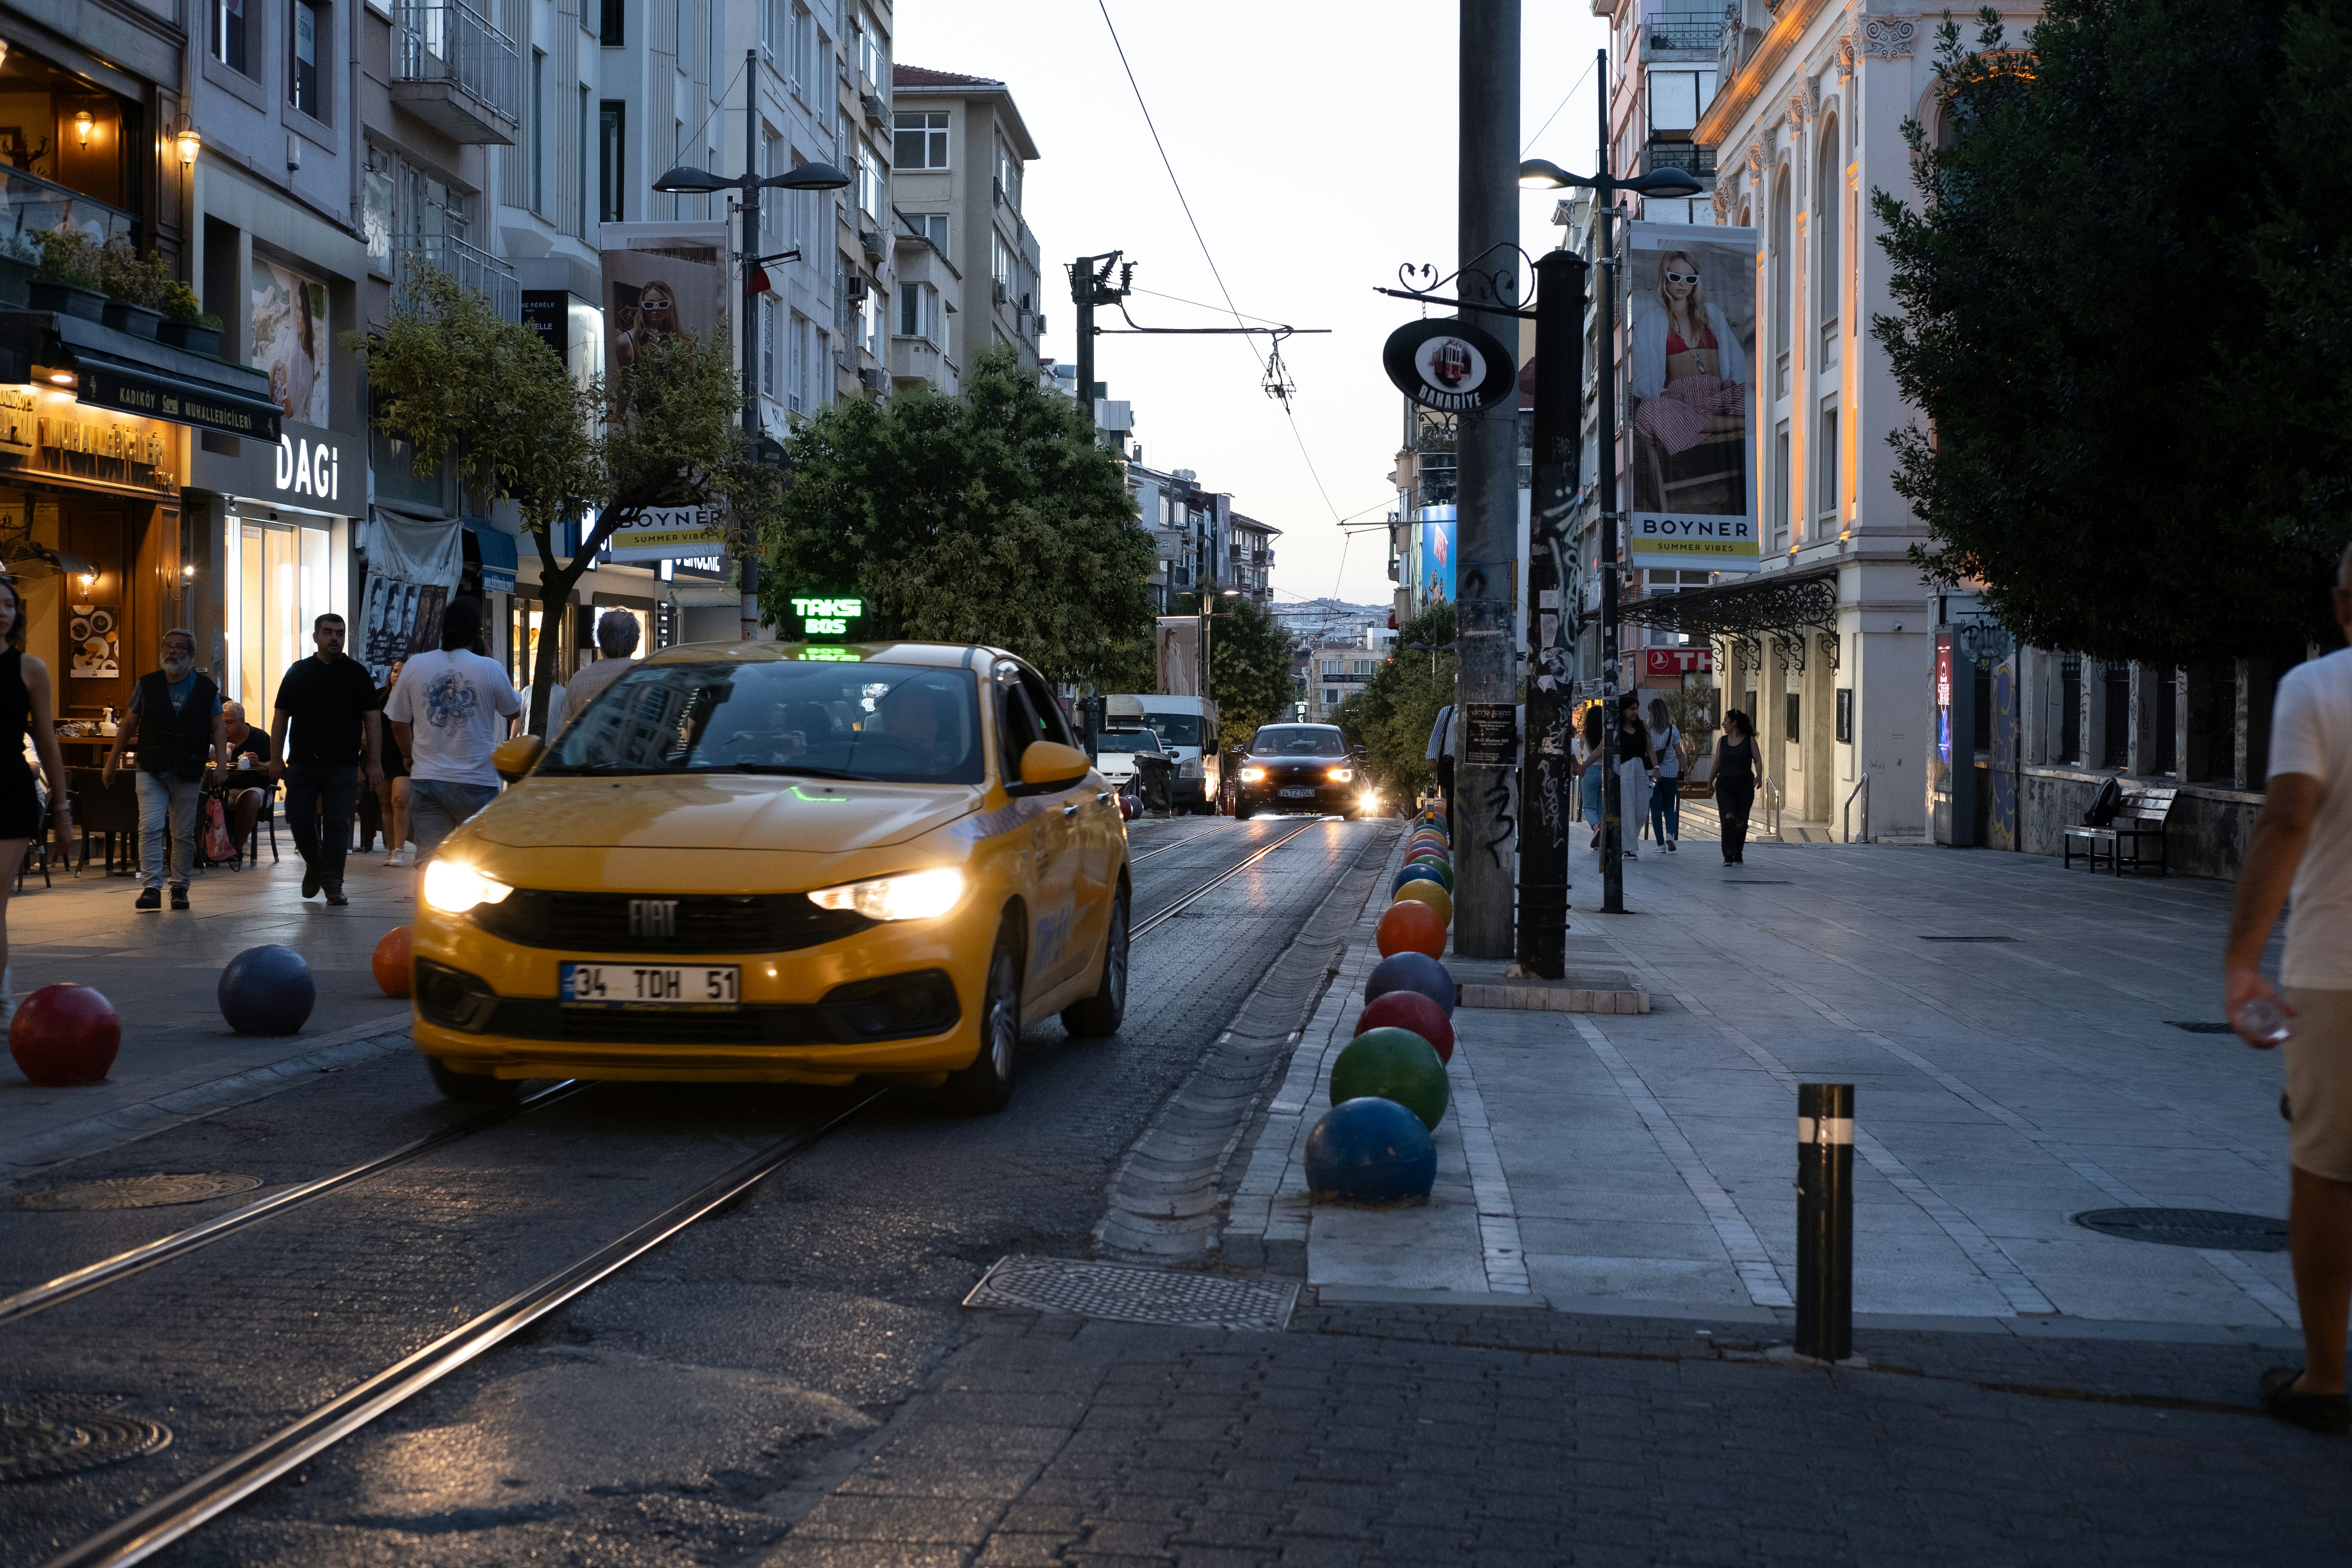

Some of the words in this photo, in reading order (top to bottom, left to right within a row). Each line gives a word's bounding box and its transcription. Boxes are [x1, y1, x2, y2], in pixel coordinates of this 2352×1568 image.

[1418, 384, 1481, 409] BAHARİYE
[120, 387, 155, 408] KADIKÖY
[185, 401, 251, 429] MUHALLEBİCİLERİ
[634, 533, 678, 543] SUMMER
[1643, 519, 1748, 537] BOYNER
[1658, 543, 1701, 551] SUMMER
[577, 968, 606, 996] 34
[634, 969, 680, 999] TDH
[706, 970, 736, 1000] 51
